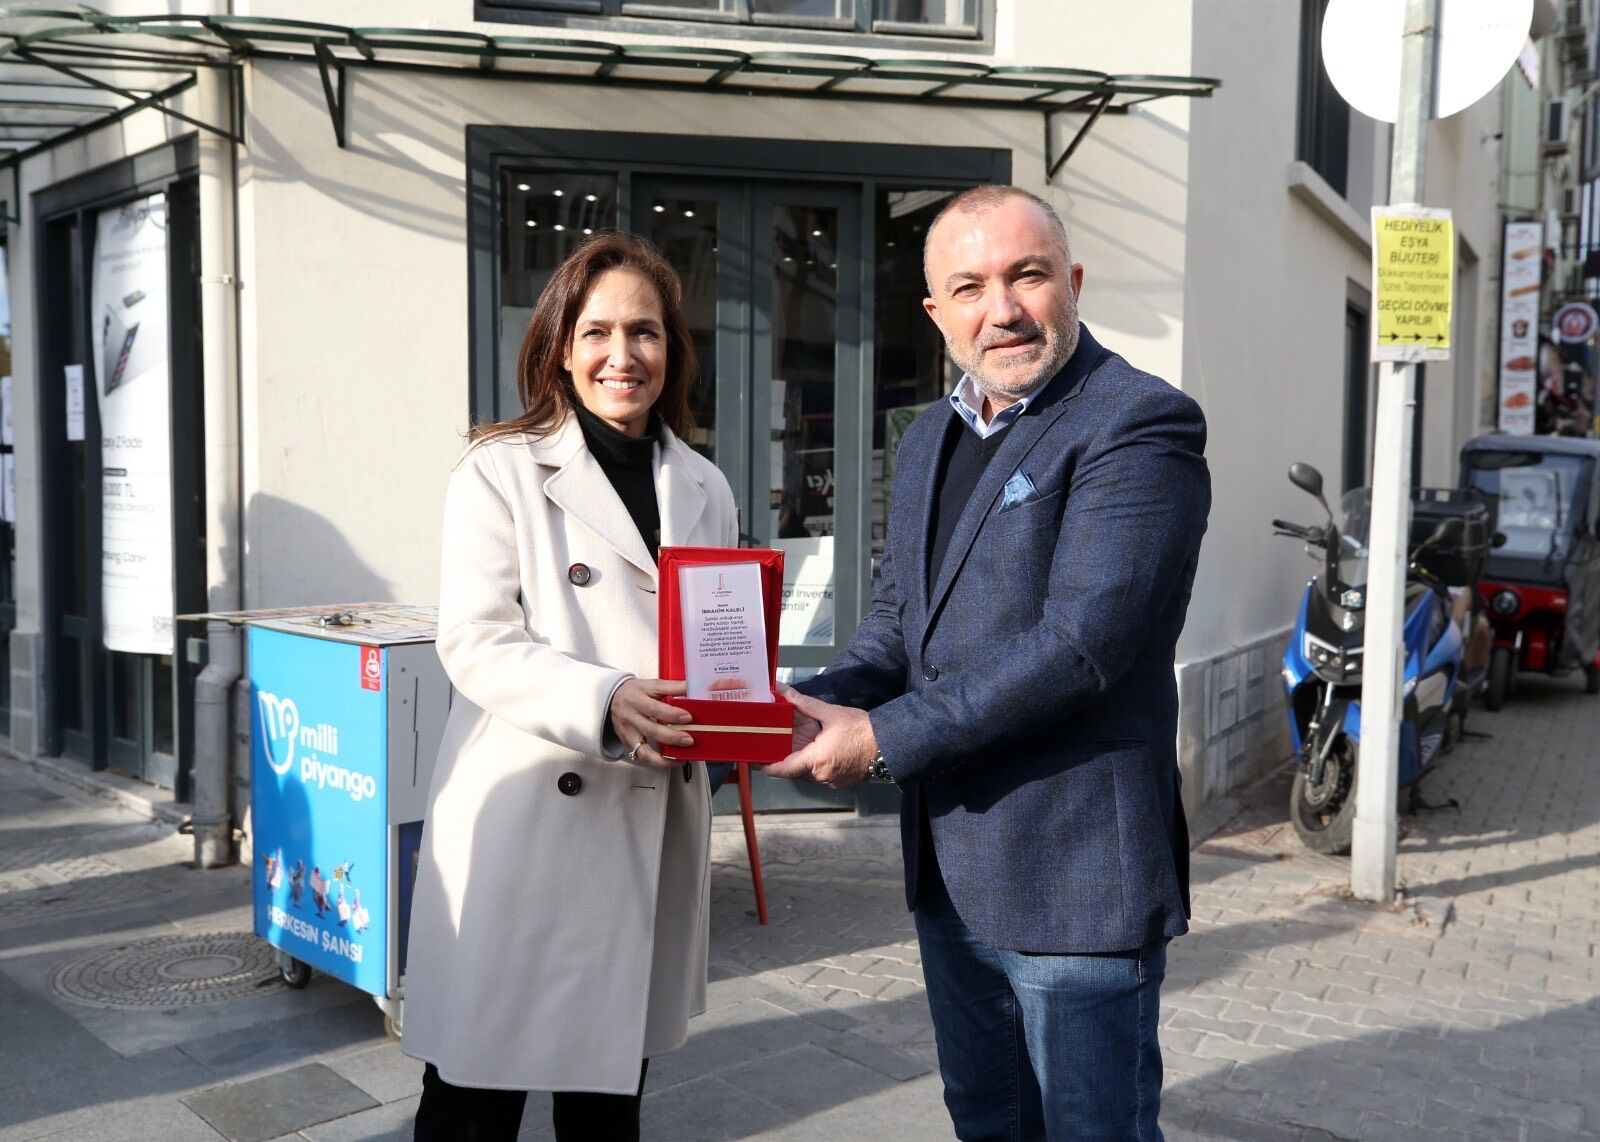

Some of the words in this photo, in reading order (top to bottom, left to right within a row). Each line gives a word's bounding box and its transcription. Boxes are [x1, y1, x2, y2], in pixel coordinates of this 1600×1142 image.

[1400, 236, 1429, 248] EŞYA
[301, 723, 338, 756] milli
[301, 752, 376, 802] piyango
